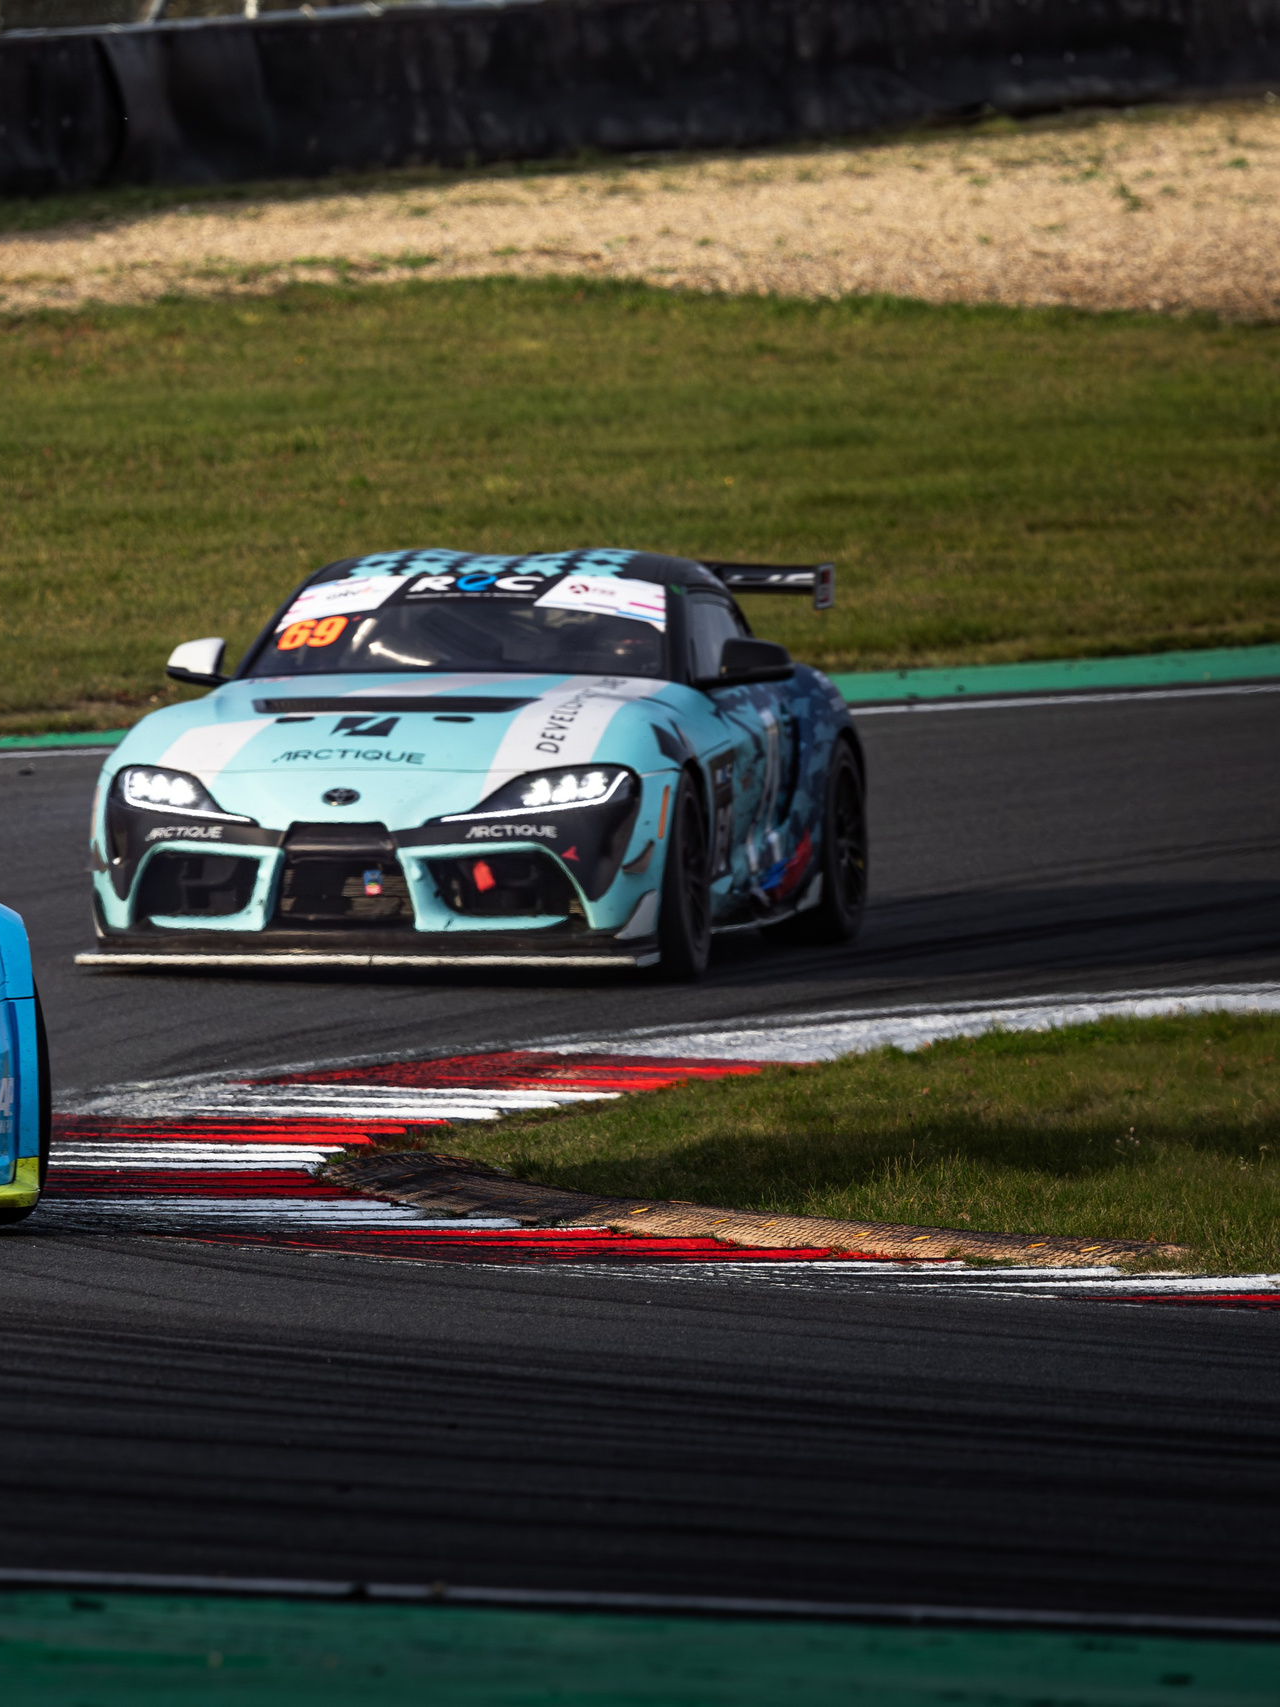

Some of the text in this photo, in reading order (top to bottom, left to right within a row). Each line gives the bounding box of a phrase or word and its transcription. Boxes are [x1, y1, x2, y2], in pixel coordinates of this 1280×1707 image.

[276, 615, 349, 651] 69
[271, 748, 426, 765] ARCTIQUE
[145, 825, 224, 842] ARCTIQUE
[464, 823, 558, 839] ARCTIQUE
